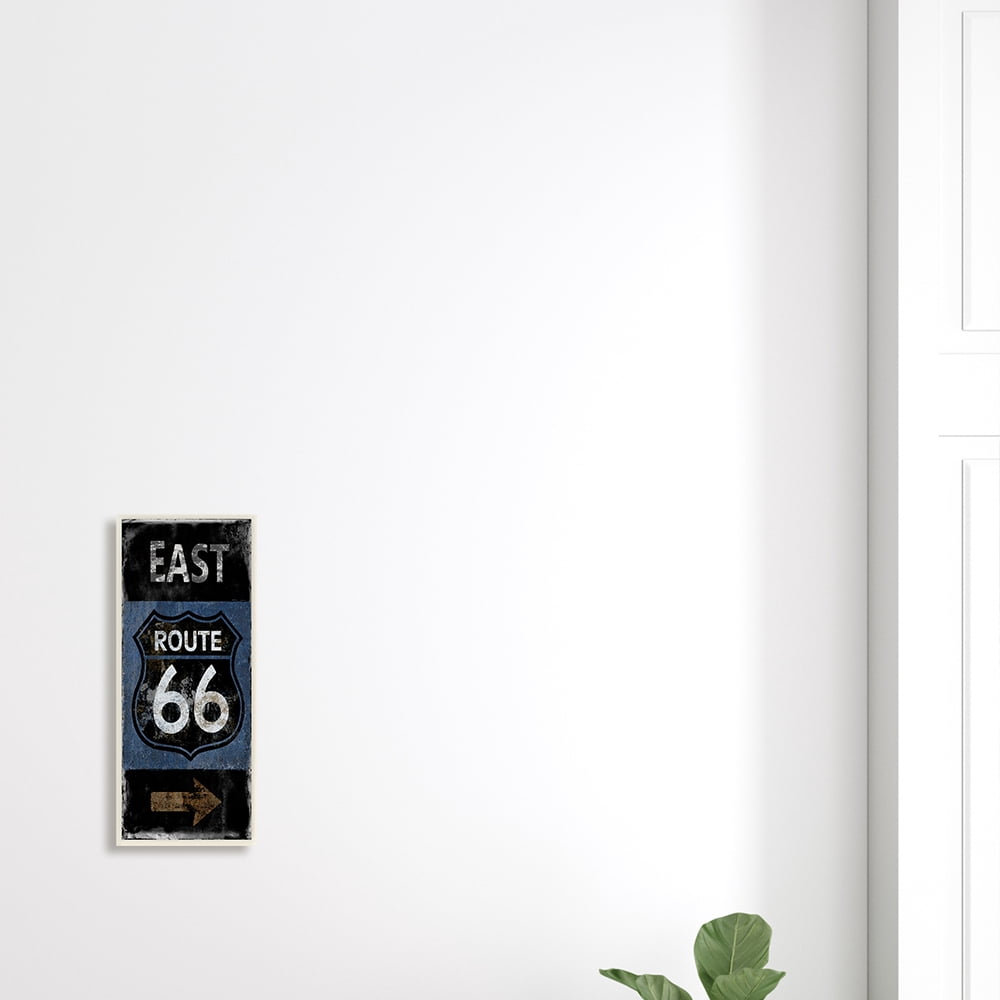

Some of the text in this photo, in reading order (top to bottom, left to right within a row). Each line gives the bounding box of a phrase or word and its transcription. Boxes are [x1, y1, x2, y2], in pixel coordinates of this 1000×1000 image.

[149, 540, 230, 583] EAST
[154, 630, 222, 652] ROUTE
[152, 664, 229, 734] 66
